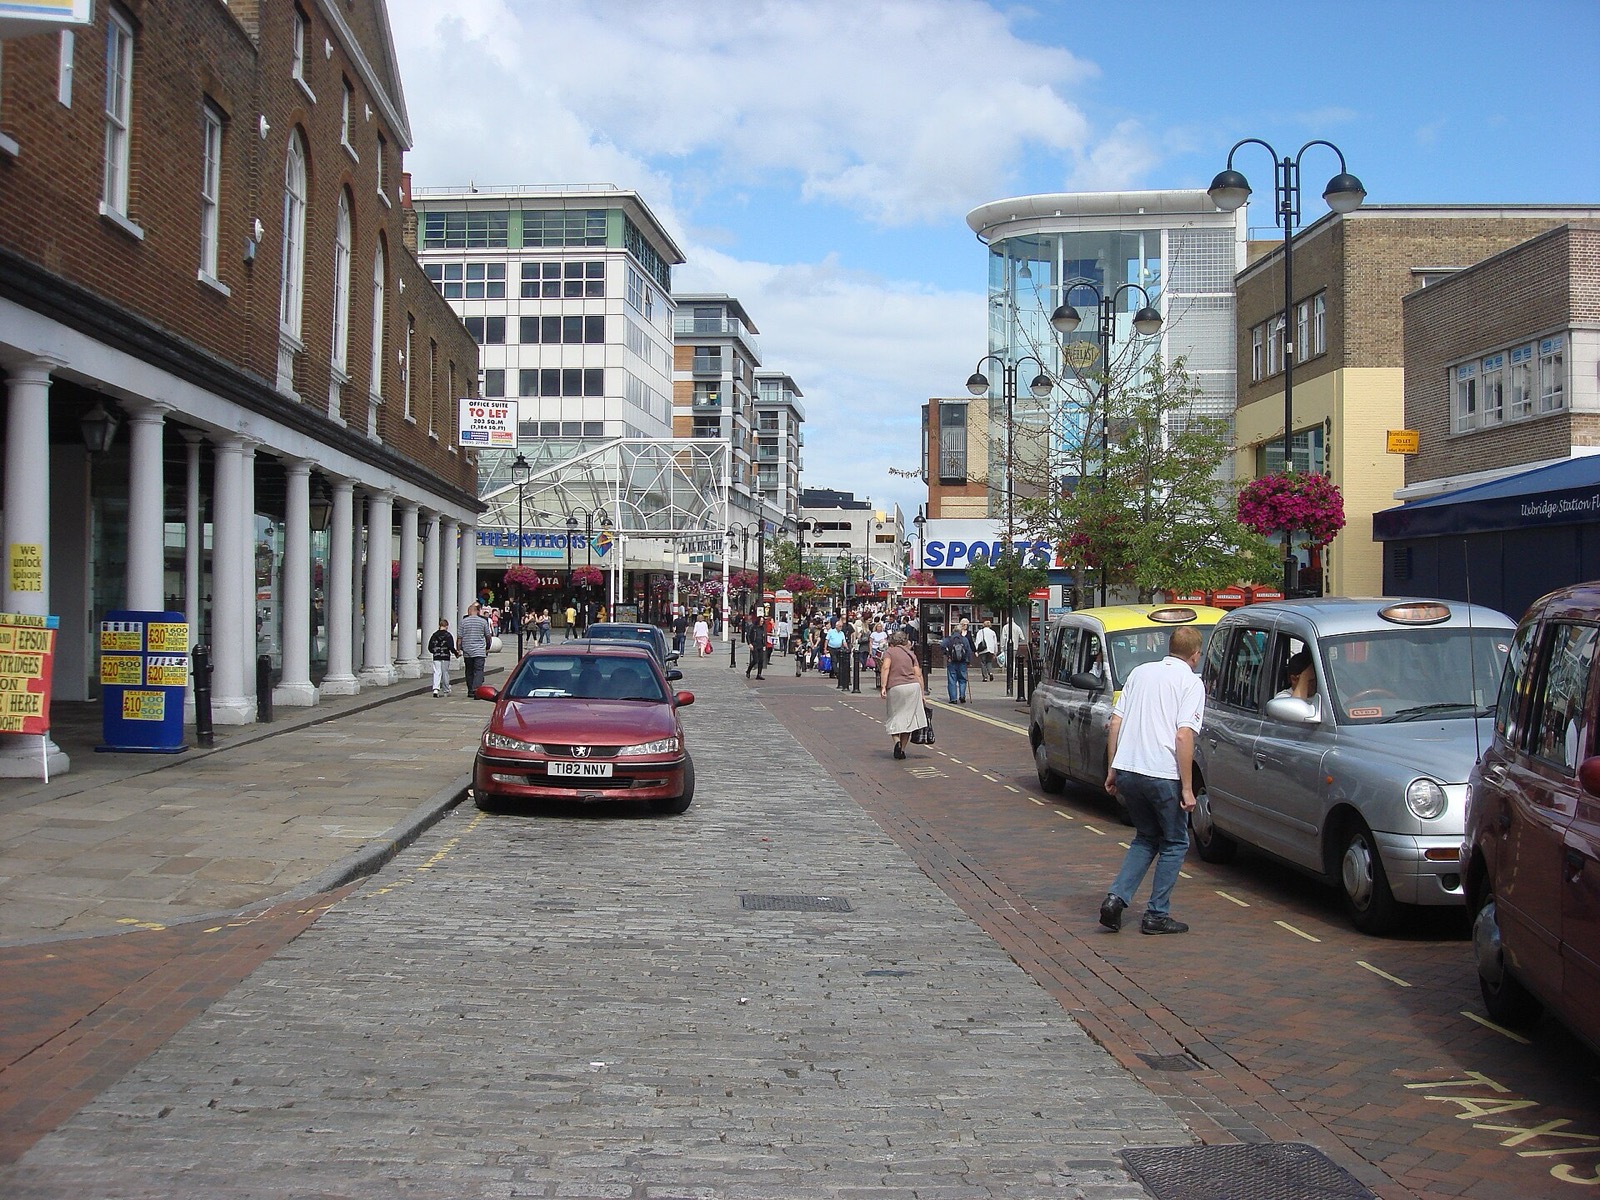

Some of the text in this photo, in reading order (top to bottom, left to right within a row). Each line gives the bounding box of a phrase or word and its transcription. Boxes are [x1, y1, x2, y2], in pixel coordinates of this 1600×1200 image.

[469, 408, 508, 418] TO LET
[1521, 494, 1600, 518] Uxbridge Station Fl
[476, 531, 503, 546] HE
[20, 545, 37, 555] we
[13, 556, 41, 568] unlock
[13, 569, 41, 580] iphone
[1402, 607, 1440, 619] TAXI
[14, 615, 43, 627] MANIA
[19, 631, 49, 651] EPSON
[102, 632, 118, 646] £35
[149, 628, 165, 643] £30
[102, 661, 119, 677] £20
[148, 666, 164, 680] £20
[0, 679, 18, 691] ON
[10, 694, 39, 713] HERE
[123, 696, 141, 712] £10
[554, 763, 607, 776] T182 NNV
